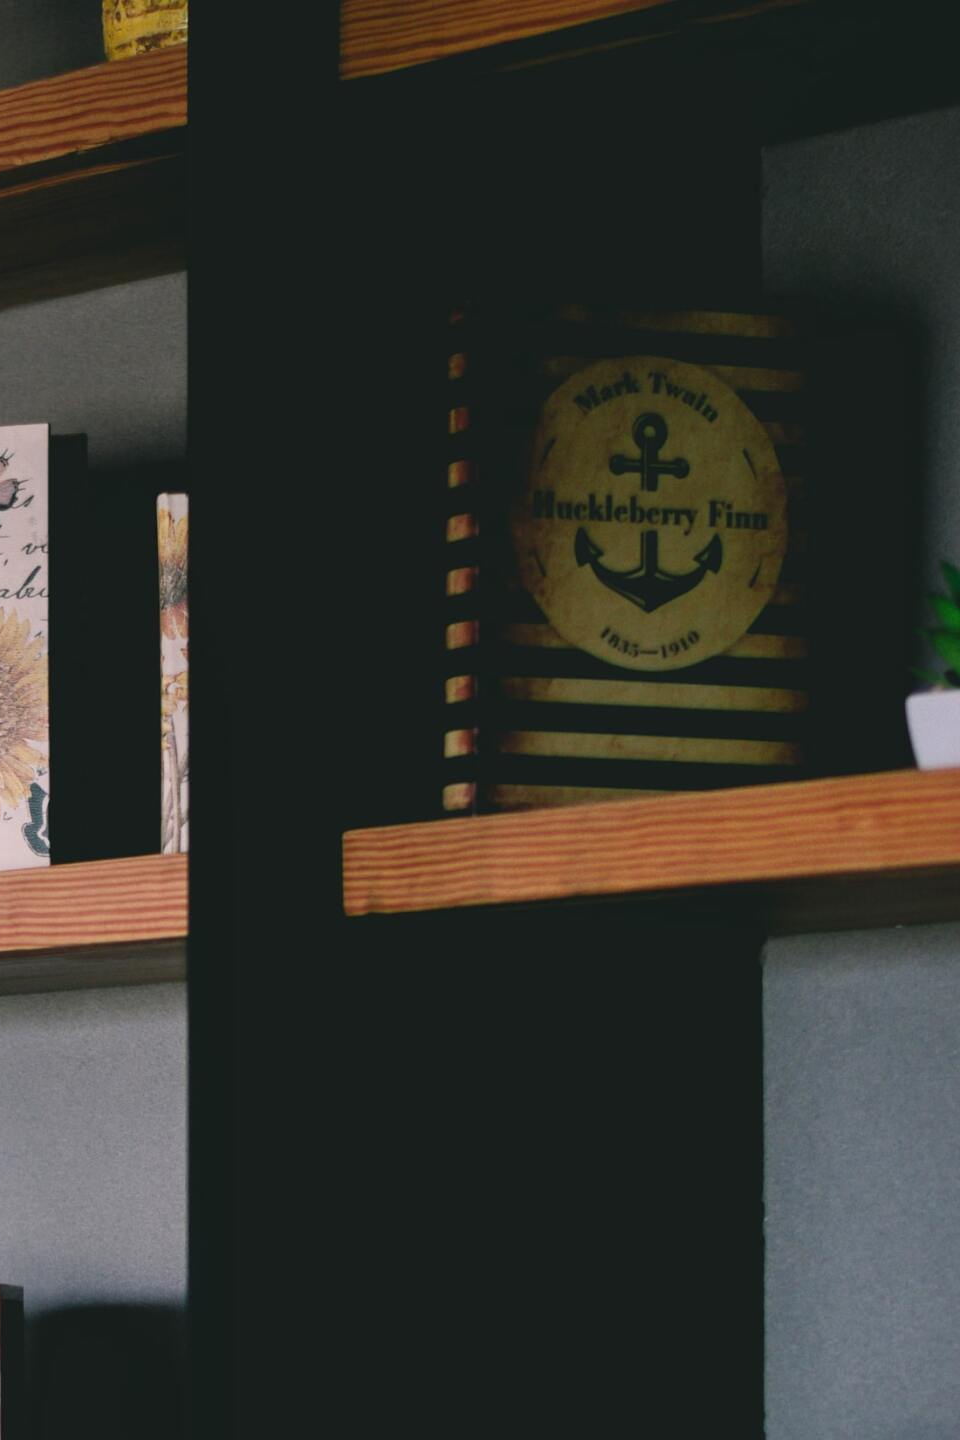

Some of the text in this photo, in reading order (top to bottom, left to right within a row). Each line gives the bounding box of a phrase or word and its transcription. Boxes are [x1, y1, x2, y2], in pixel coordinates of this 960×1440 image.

[574, 371, 719, 423] Mark Twain
[531, 489, 768, 536] Huckleberry Finn
